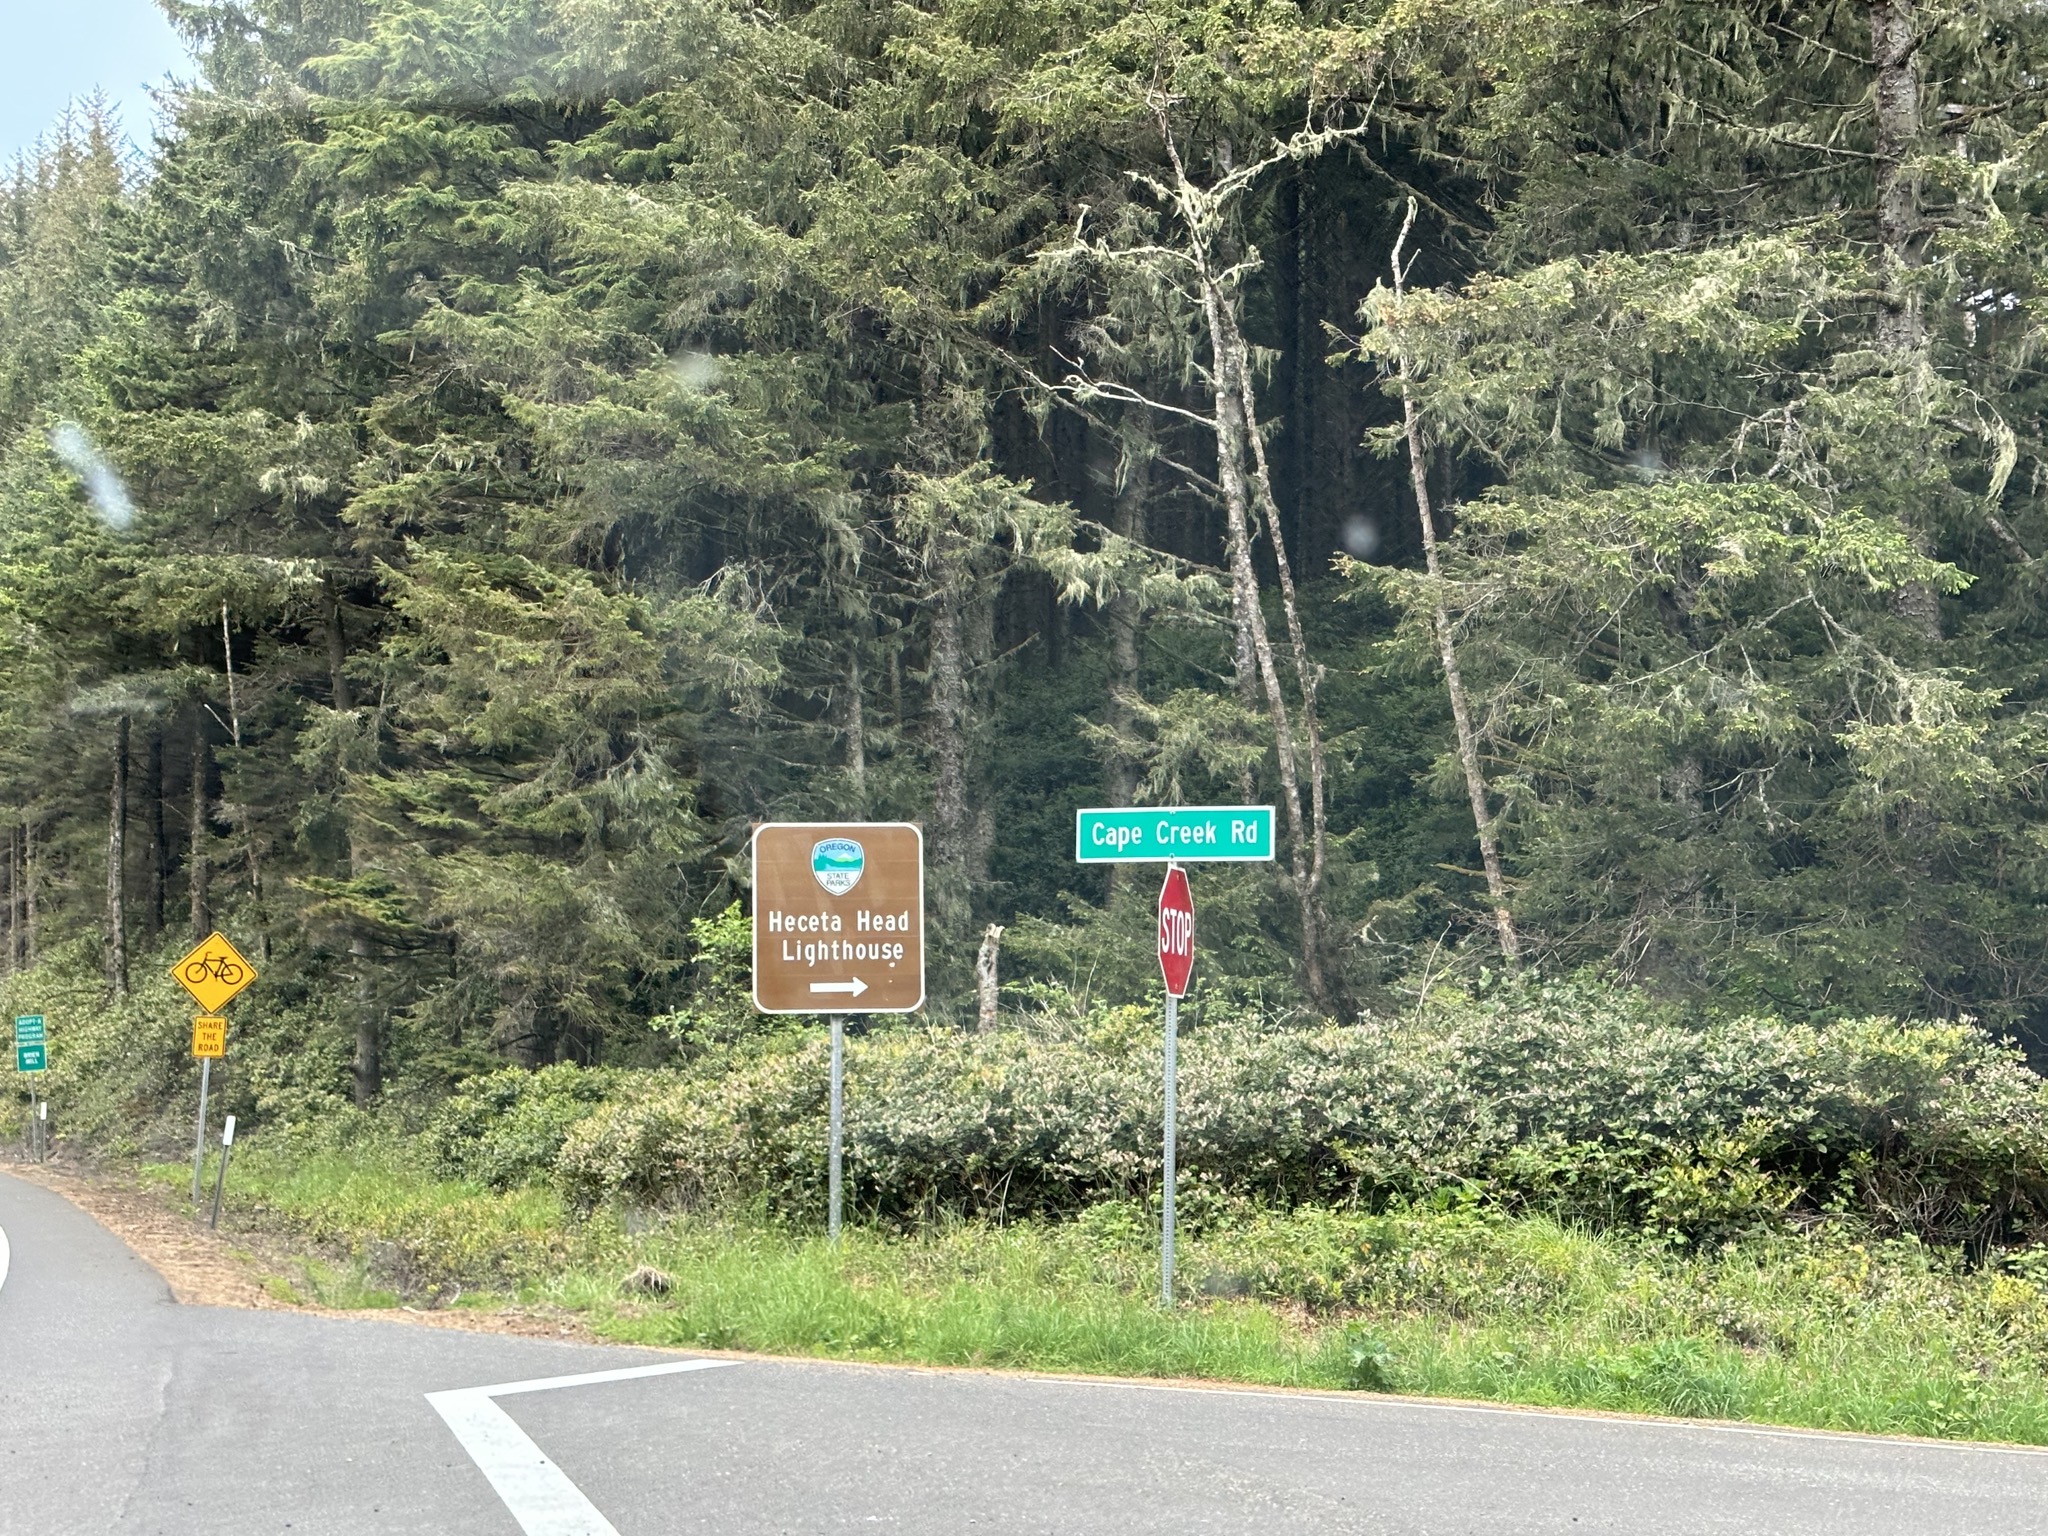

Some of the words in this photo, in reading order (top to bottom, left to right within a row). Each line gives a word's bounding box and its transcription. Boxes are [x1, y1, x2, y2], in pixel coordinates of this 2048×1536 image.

[1091, 821, 1143, 852] Cape
[1156, 820, 1217, 844] Creek
[1231, 819, 1258, 843] Rd
[819, 843, 857, 853] OREGON
[826, 872, 849, 880] STATE
[768, 911, 842, 932] Heceta
[856, 910, 909, 932] Head
[1161, 907, 1192, 956] STOP
[782, 939, 904, 968] Lighthouse
[198, 1021, 223, 1030] SHARE
[202, 1032, 217, 1041] THE
[198, 1043, 219, 1052] ROAD
